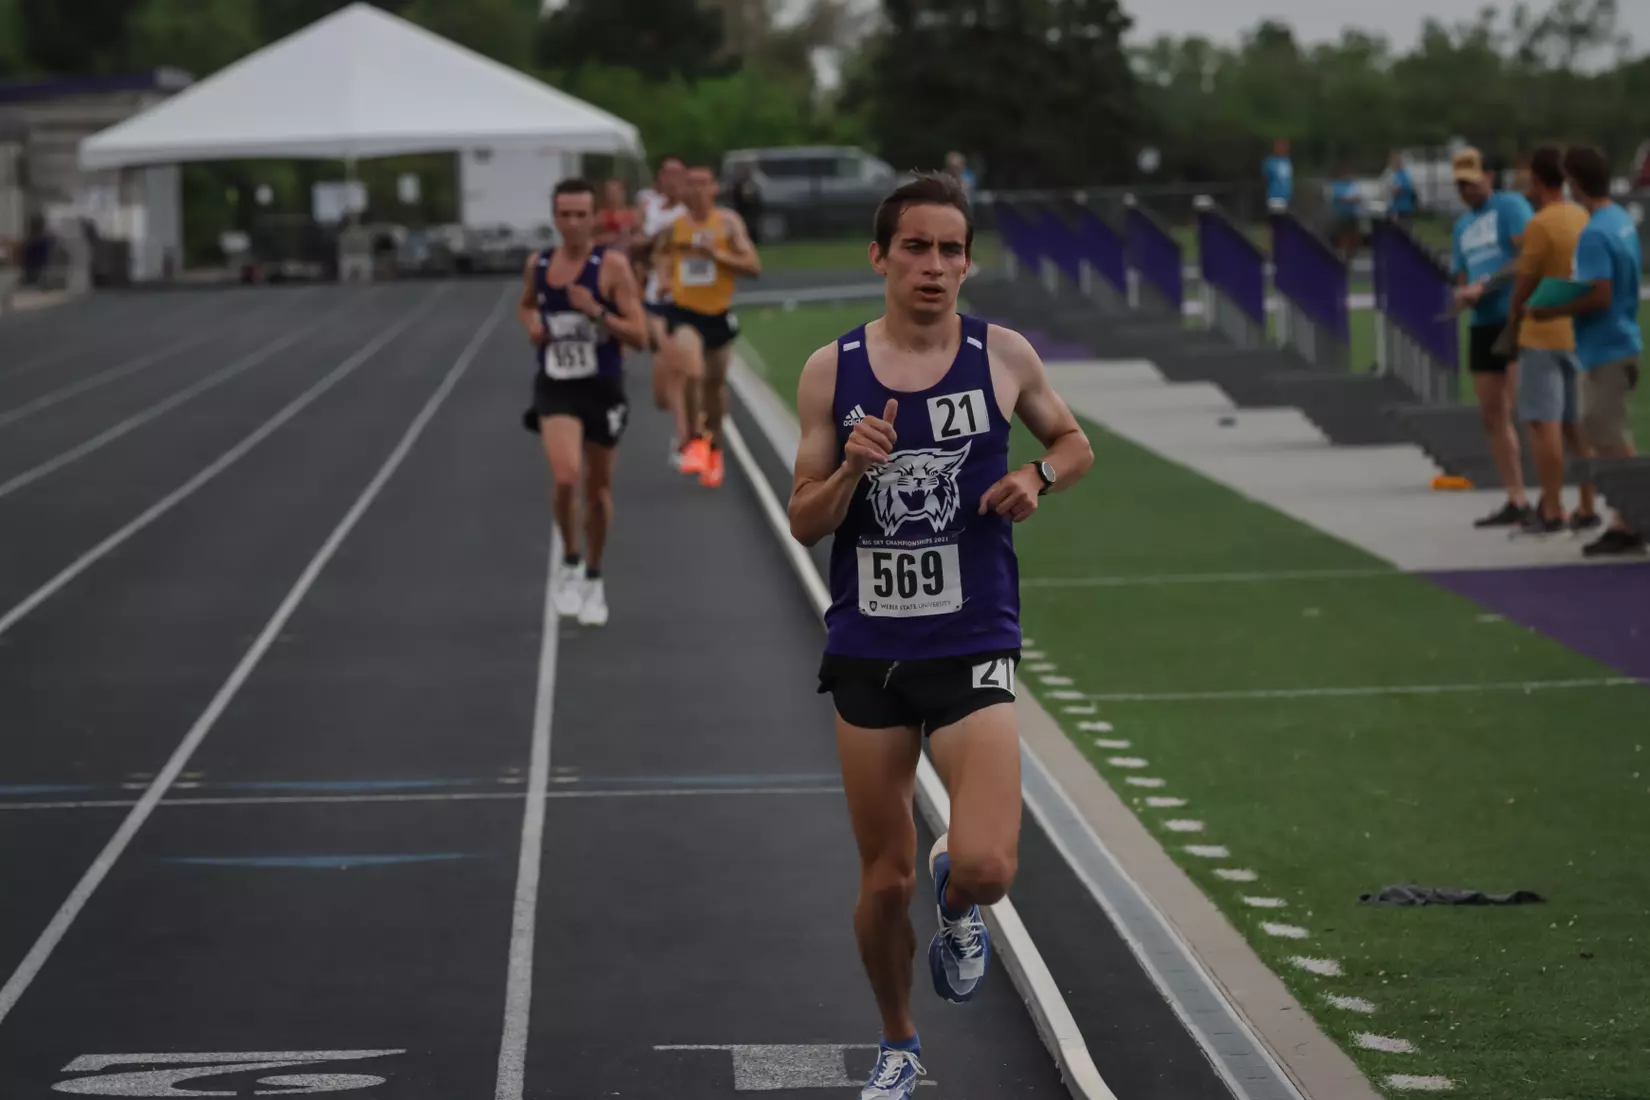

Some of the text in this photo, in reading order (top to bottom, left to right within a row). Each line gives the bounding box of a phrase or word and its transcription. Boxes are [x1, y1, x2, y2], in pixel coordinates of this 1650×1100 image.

[843, 417, 864, 427] adid
[936, 393, 977, 438] 21
[885, 537, 933, 547] CHAMPIONSHIPS
[872, 550, 944, 599] 569
[880, 600, 951, 611] WEBER STATE UNIVERSITY
[980, 657, 1011, 691] 21
